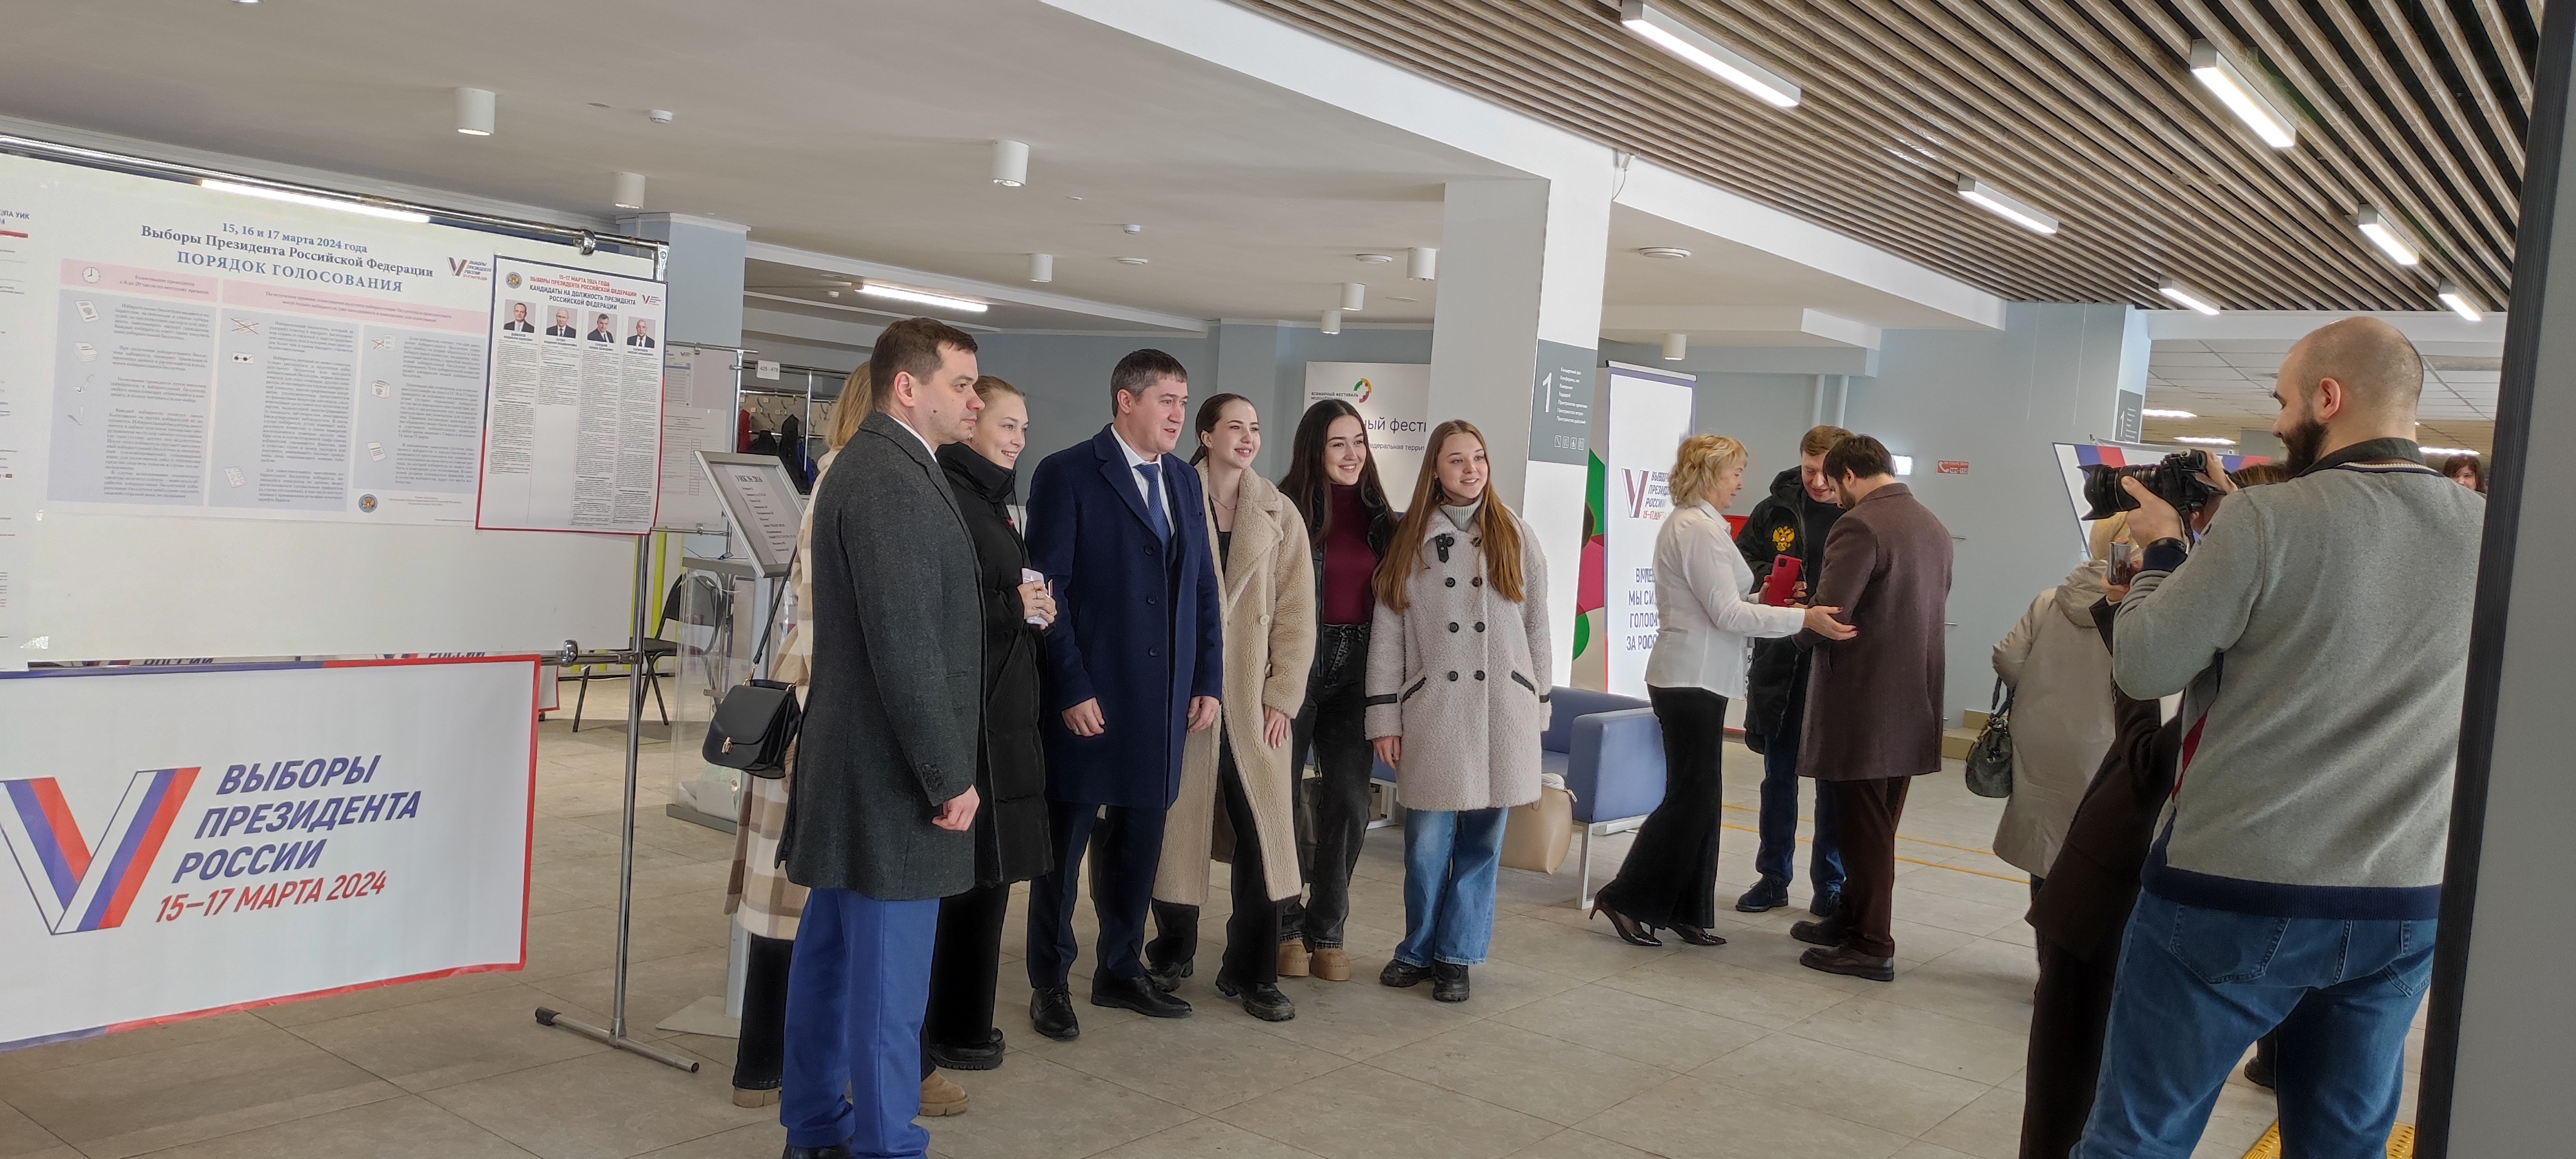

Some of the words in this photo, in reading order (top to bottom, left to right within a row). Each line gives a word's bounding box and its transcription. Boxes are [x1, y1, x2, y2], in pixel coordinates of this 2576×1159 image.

[141, 225, 202, 245] Выборы
[205, 234, 286, 256] Президента
[289, 246, 364, 267] Российской
[366, 258, 434, 278] Федерации
[223, 223, 238, 235] 15,
[242, 226, 254, 235] 16
[268, 230, 280, 239] 17
[282, 234, 314, 246] марта
[317, 238, 342, 249] 2024
[344, 244, 368, 254] года
[177, 251, 266, 274] ПОРЯДОК
[272, 264, 403, 292] ГОЛОСОВАНИЯ
[551, 279, 580, 289] ПРЕЗИДЕНТА
[581, 284, 610, 293] РОССИЙСКОЙ
[611, 288, 637, 297] ФЕДЕРАЦИИ
[530, 284, 562, 295] КАНДИДАТЫ
[571, 291, 603, 301] ДОЛЖНОСТЬ
[605, 295, 636, 305] ПРЕЗИДЕНТА
[549, 295, 585, 305] РОССИЙСКОЙ
[586, 300, 617, 310] ФЕДЕРАЦИИ
[1542, 372, 1552, 413] 1
[1629, 591, 1642, 606] МЫ
[1627, 635, 1636, 651] ЗА
[215, 754, 382, 795] ВЫБОРЫ
[194, 790, 422, 839] ПРЕЗИДЕНТА
[171, 838, 328, 884] РОССИИ
[156, 888, 235, 923] 15–17
[233, 878, 324, 913] МАРТА
[325, 870, 388, 900] 2024
